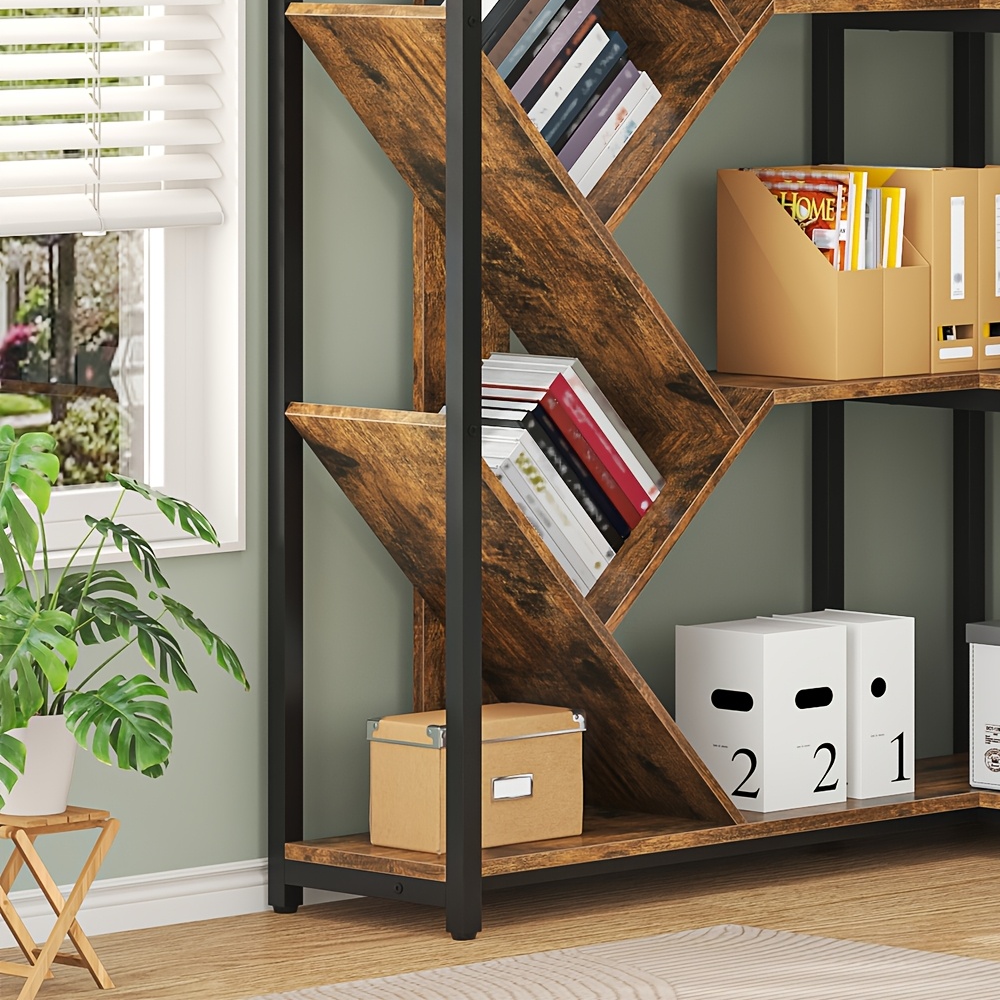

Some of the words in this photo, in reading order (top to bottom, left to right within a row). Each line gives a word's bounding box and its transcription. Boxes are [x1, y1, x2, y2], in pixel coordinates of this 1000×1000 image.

[780, 191, 836, 221] HOME
[731, 748, 761, 799] 2
[813, 742, 840, 794] 2
[890, 731, 911, 783] 1
